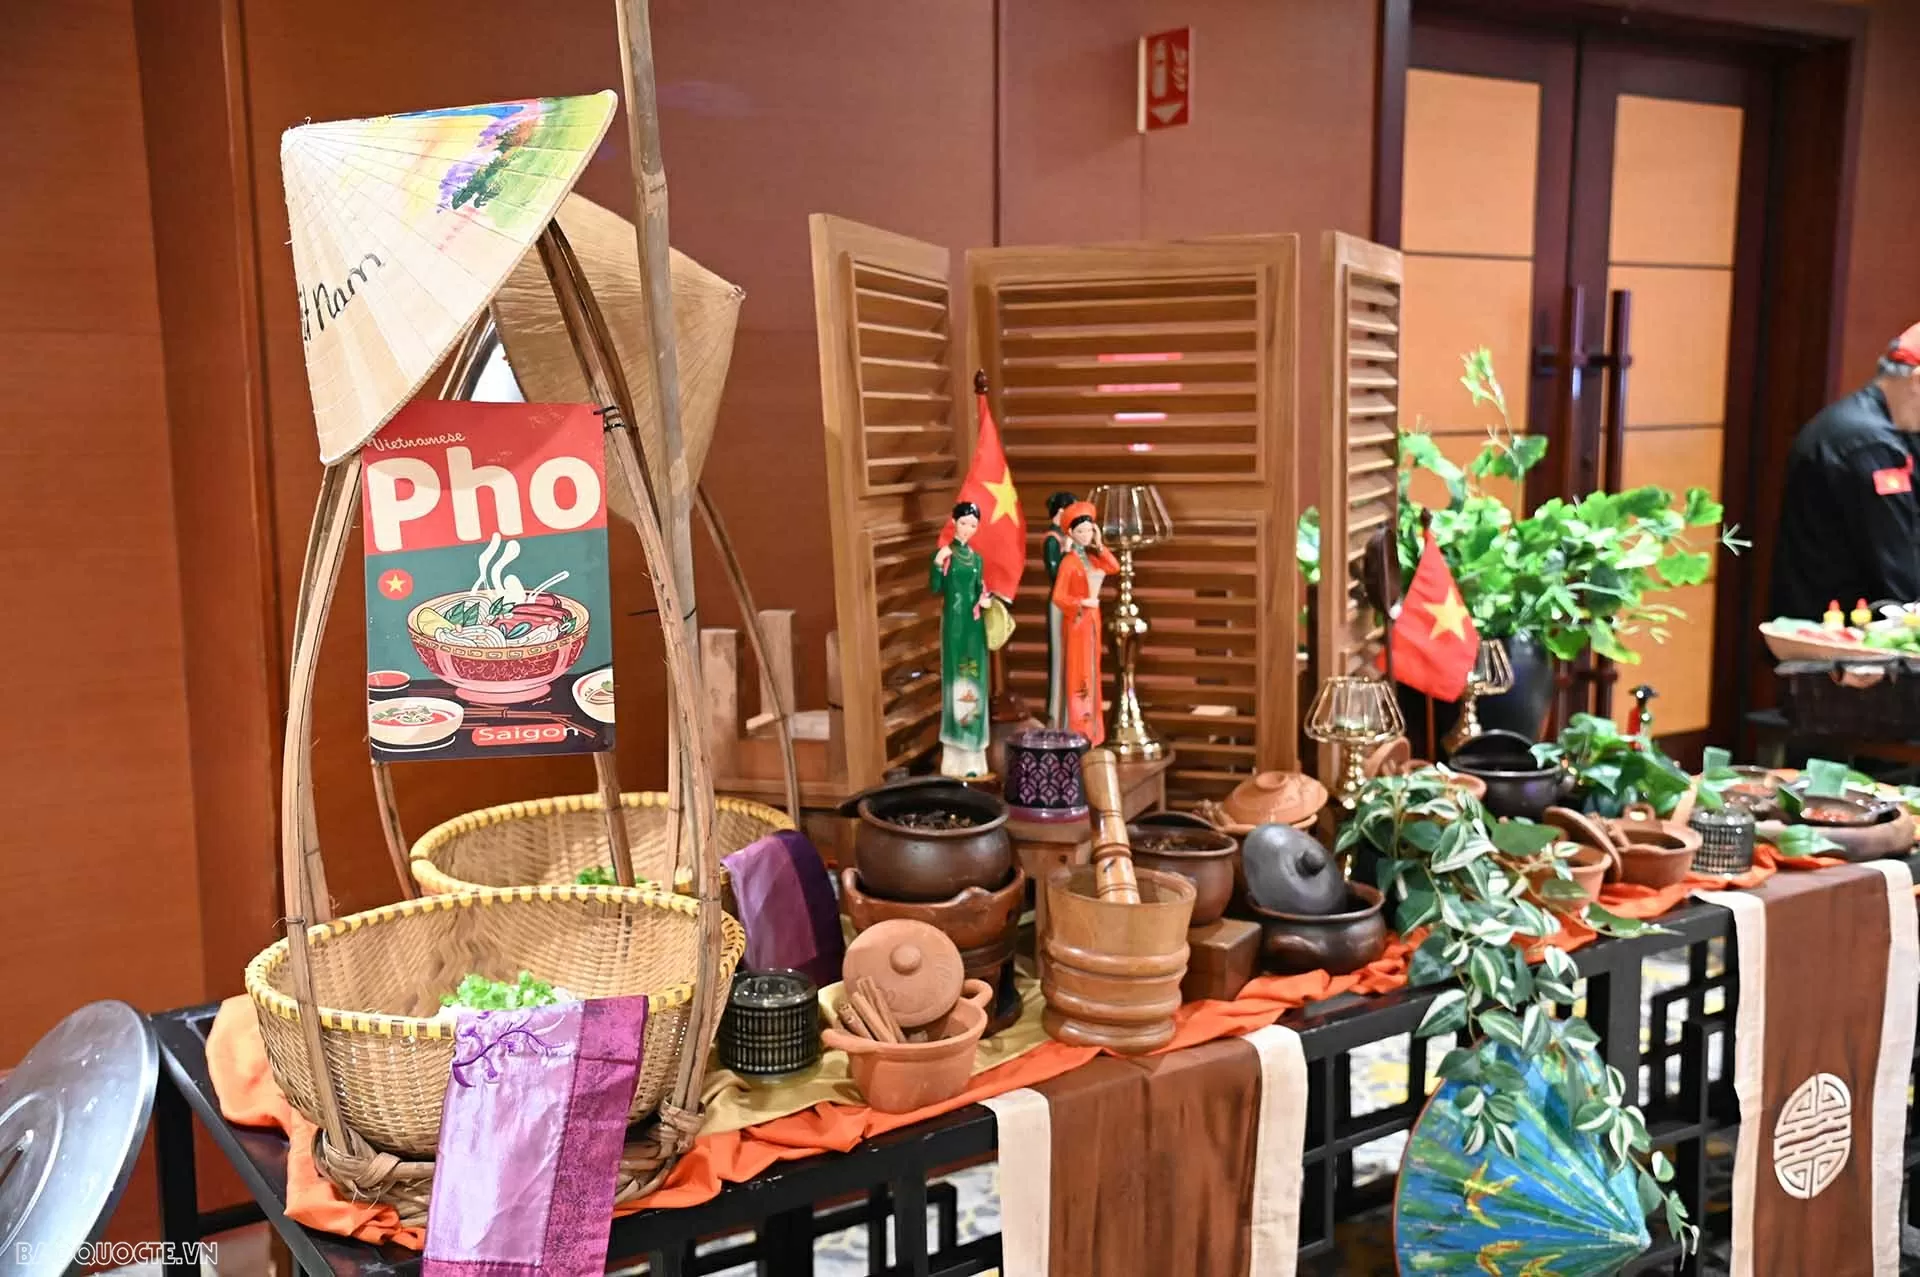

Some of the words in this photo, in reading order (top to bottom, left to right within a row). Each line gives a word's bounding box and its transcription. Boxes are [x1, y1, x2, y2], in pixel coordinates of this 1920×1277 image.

[368, 432, 466, 451] Vietnamese
[366, 446, 601, 552] Pho
[478, 726, 579, 742] Saigon
